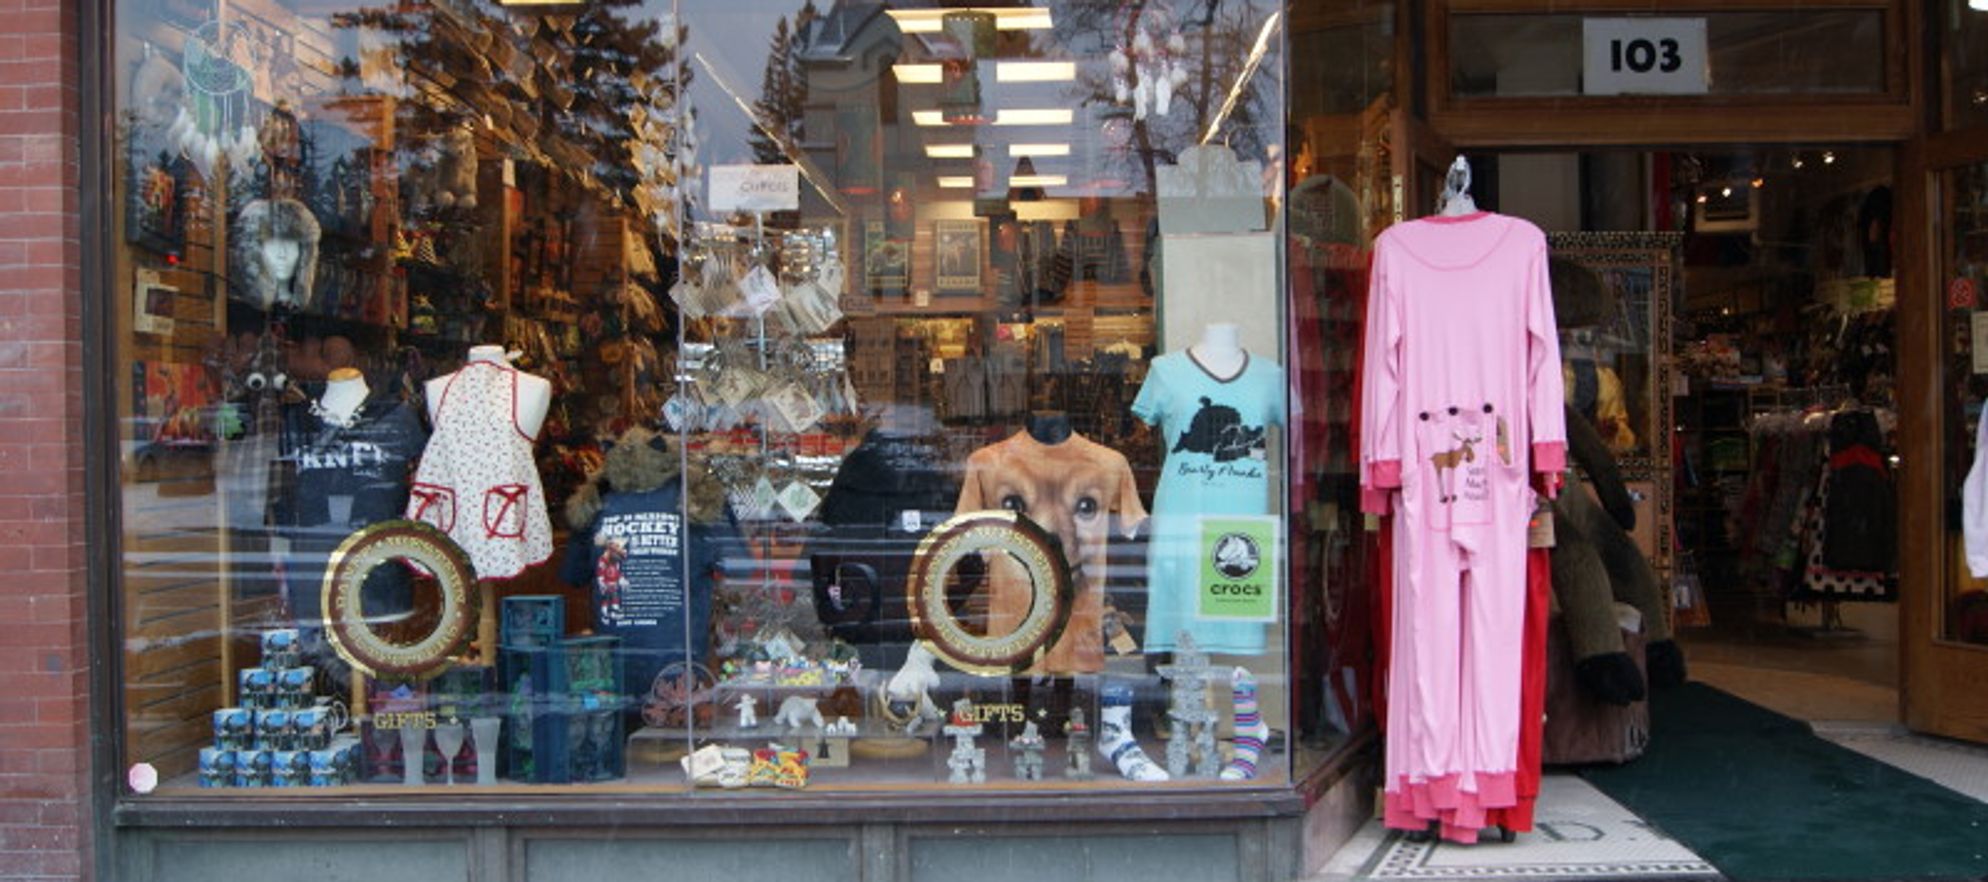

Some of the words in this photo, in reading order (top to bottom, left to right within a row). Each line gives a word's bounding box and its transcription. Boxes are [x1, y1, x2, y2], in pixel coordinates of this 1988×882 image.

[1611, 38, 1682, 73] 103
[600, 522, 680, 535] HOCKEY
[1210, 584, 1262, 595] crocs
[374, 711, 437, 730] GIFTS
[959, 704, 1025, 722] GIFTS
